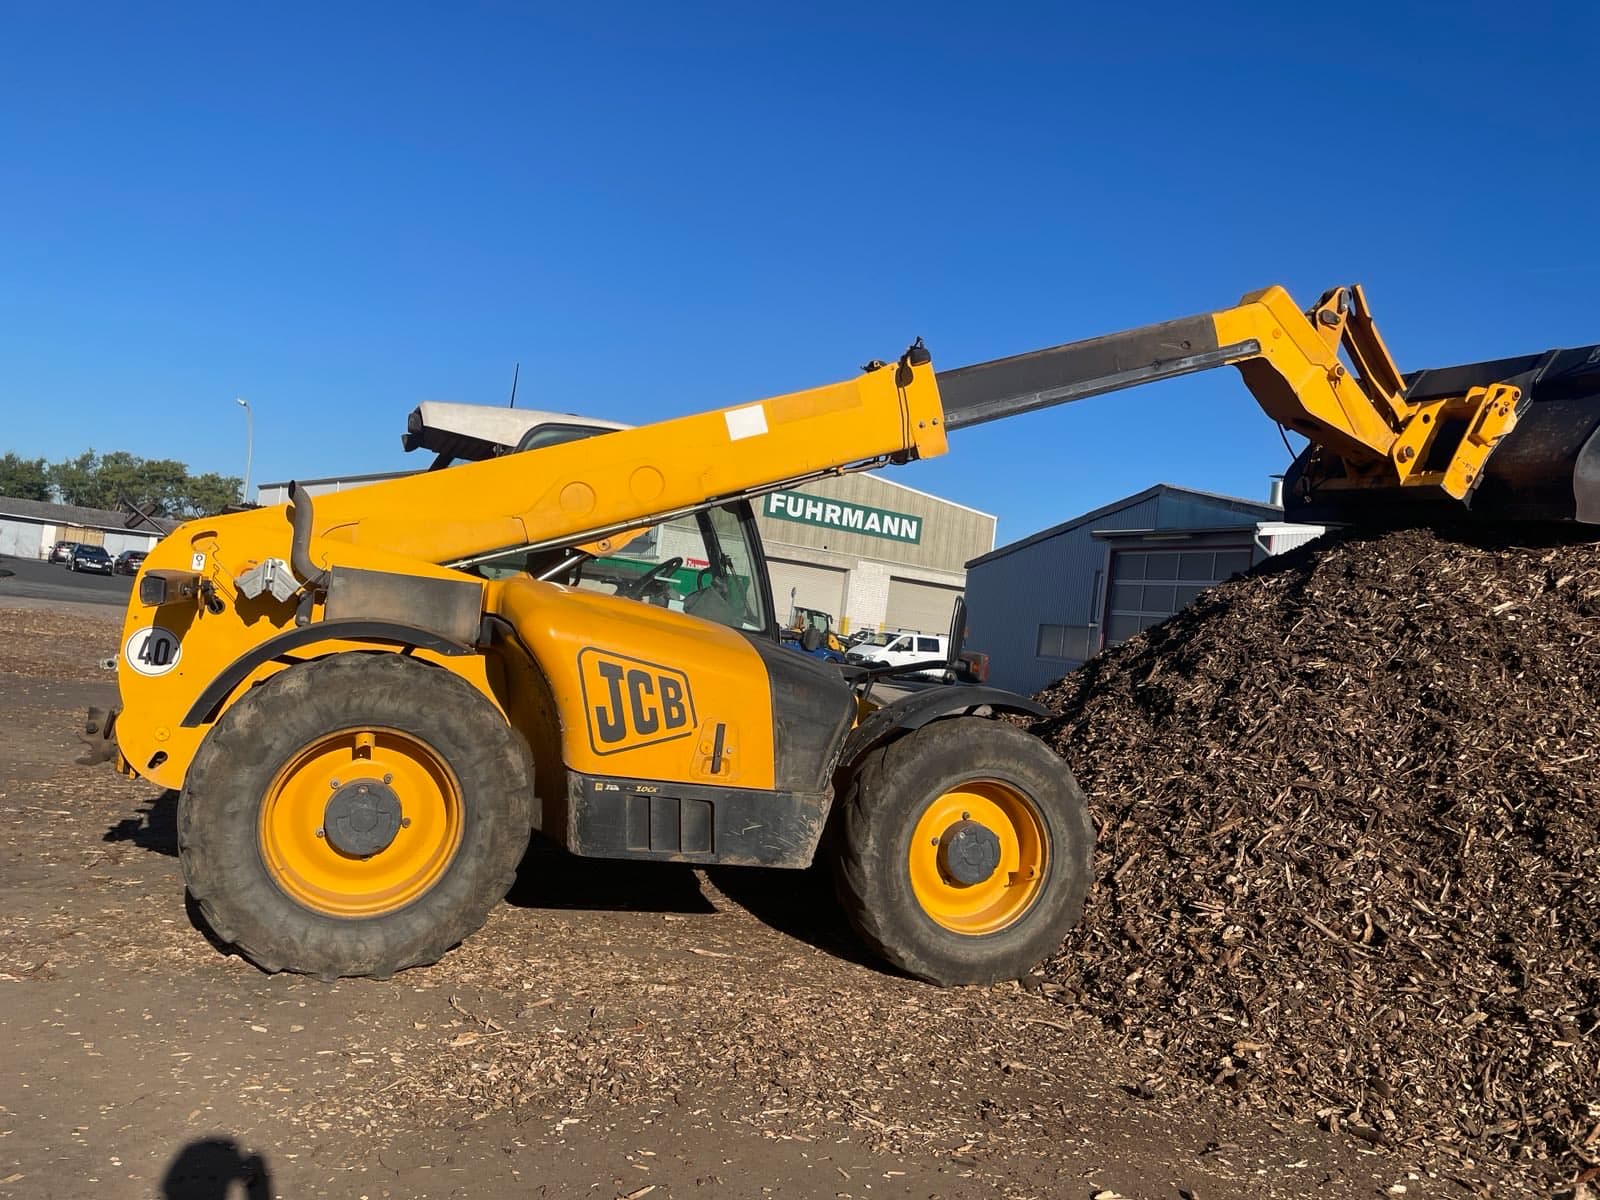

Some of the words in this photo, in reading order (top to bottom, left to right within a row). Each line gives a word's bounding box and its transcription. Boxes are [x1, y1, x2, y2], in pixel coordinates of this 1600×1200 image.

[769, 492, 918, 540] FUHRMANN
[138, 636, 171, 666] 40
[595, 660, 687, 743] JCB
